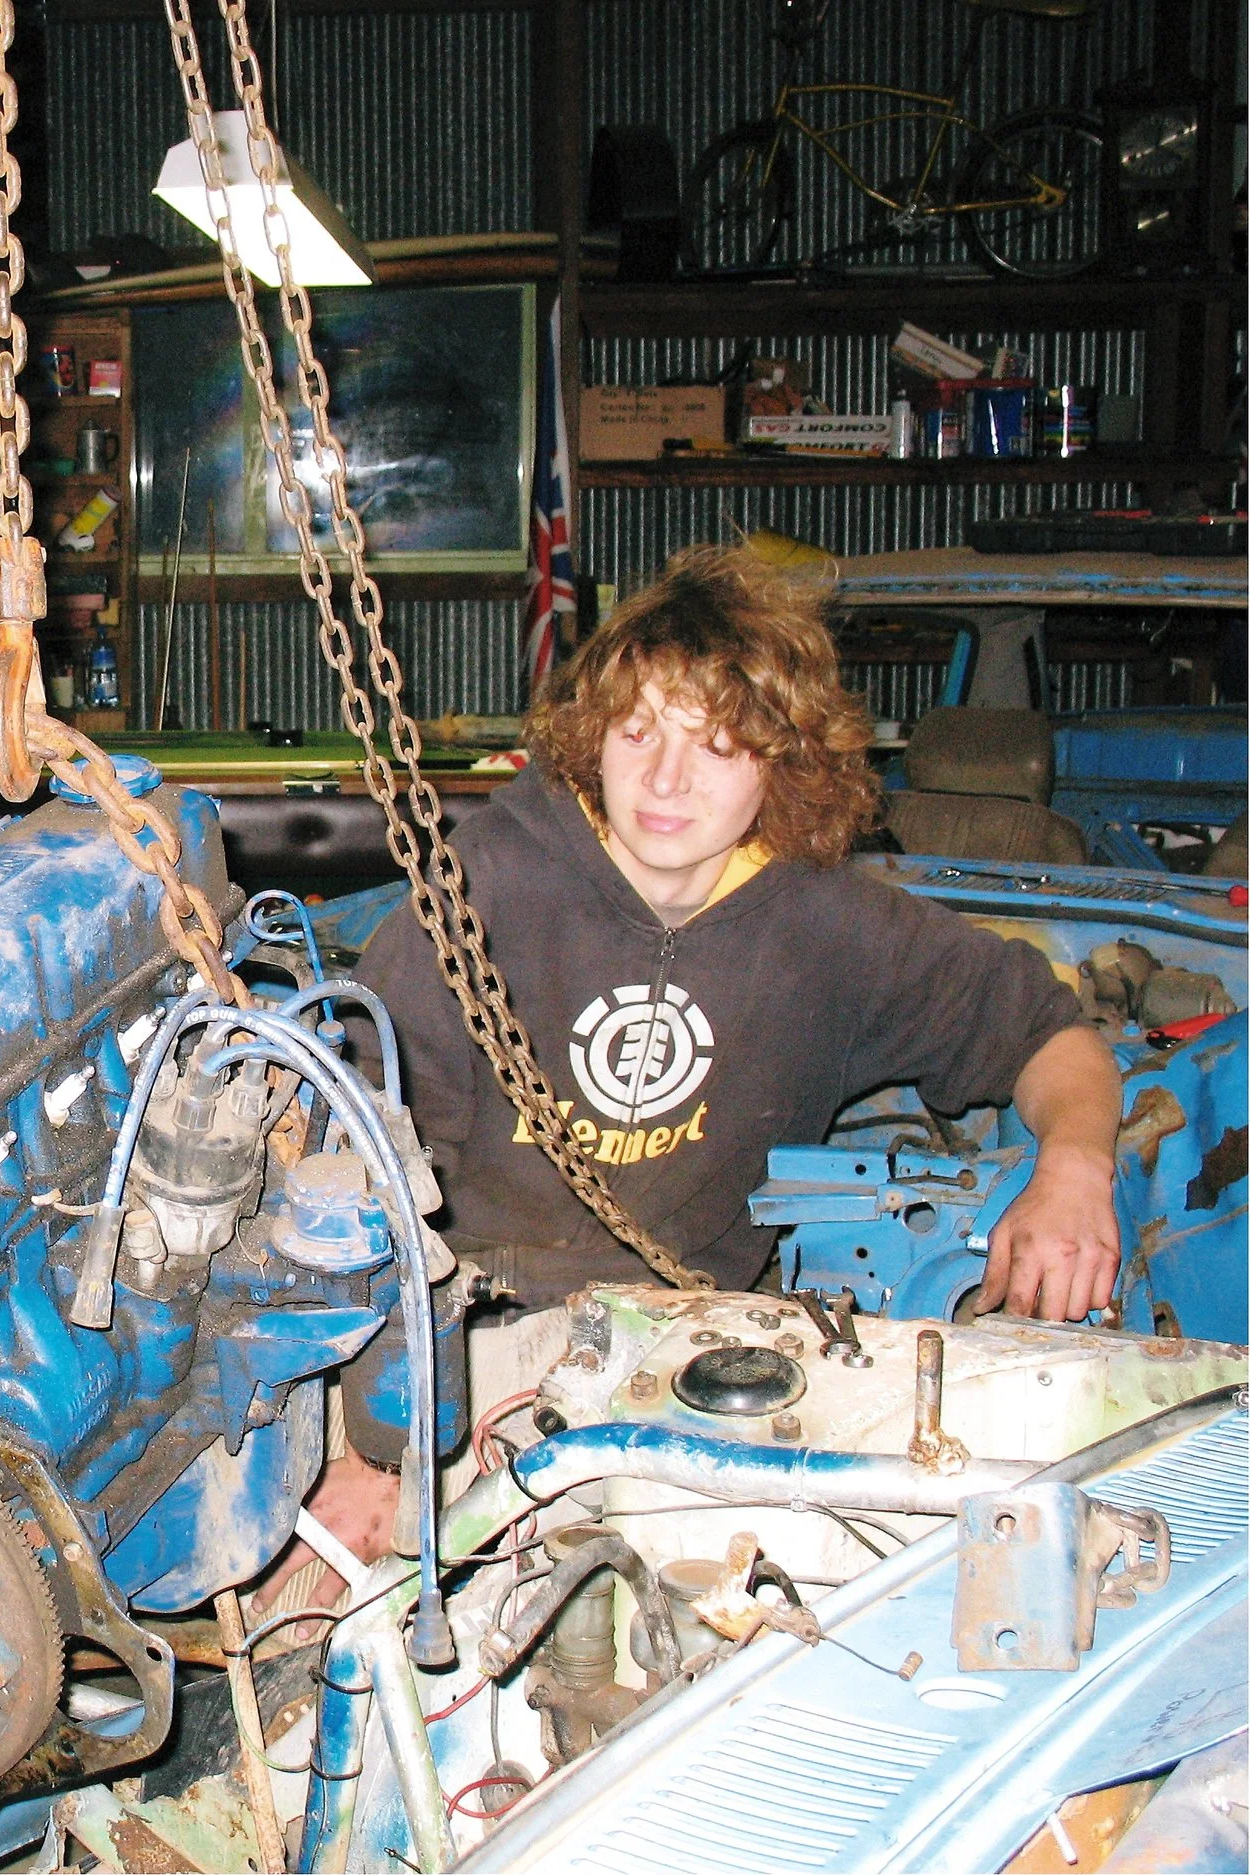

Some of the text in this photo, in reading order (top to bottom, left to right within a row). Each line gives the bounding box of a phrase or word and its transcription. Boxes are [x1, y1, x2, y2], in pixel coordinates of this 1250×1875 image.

[796, 422, 887, 433] COMFORT
[183, 1009, 206, 1025] TOP
[209, 1008, 238, 1021] GUN
